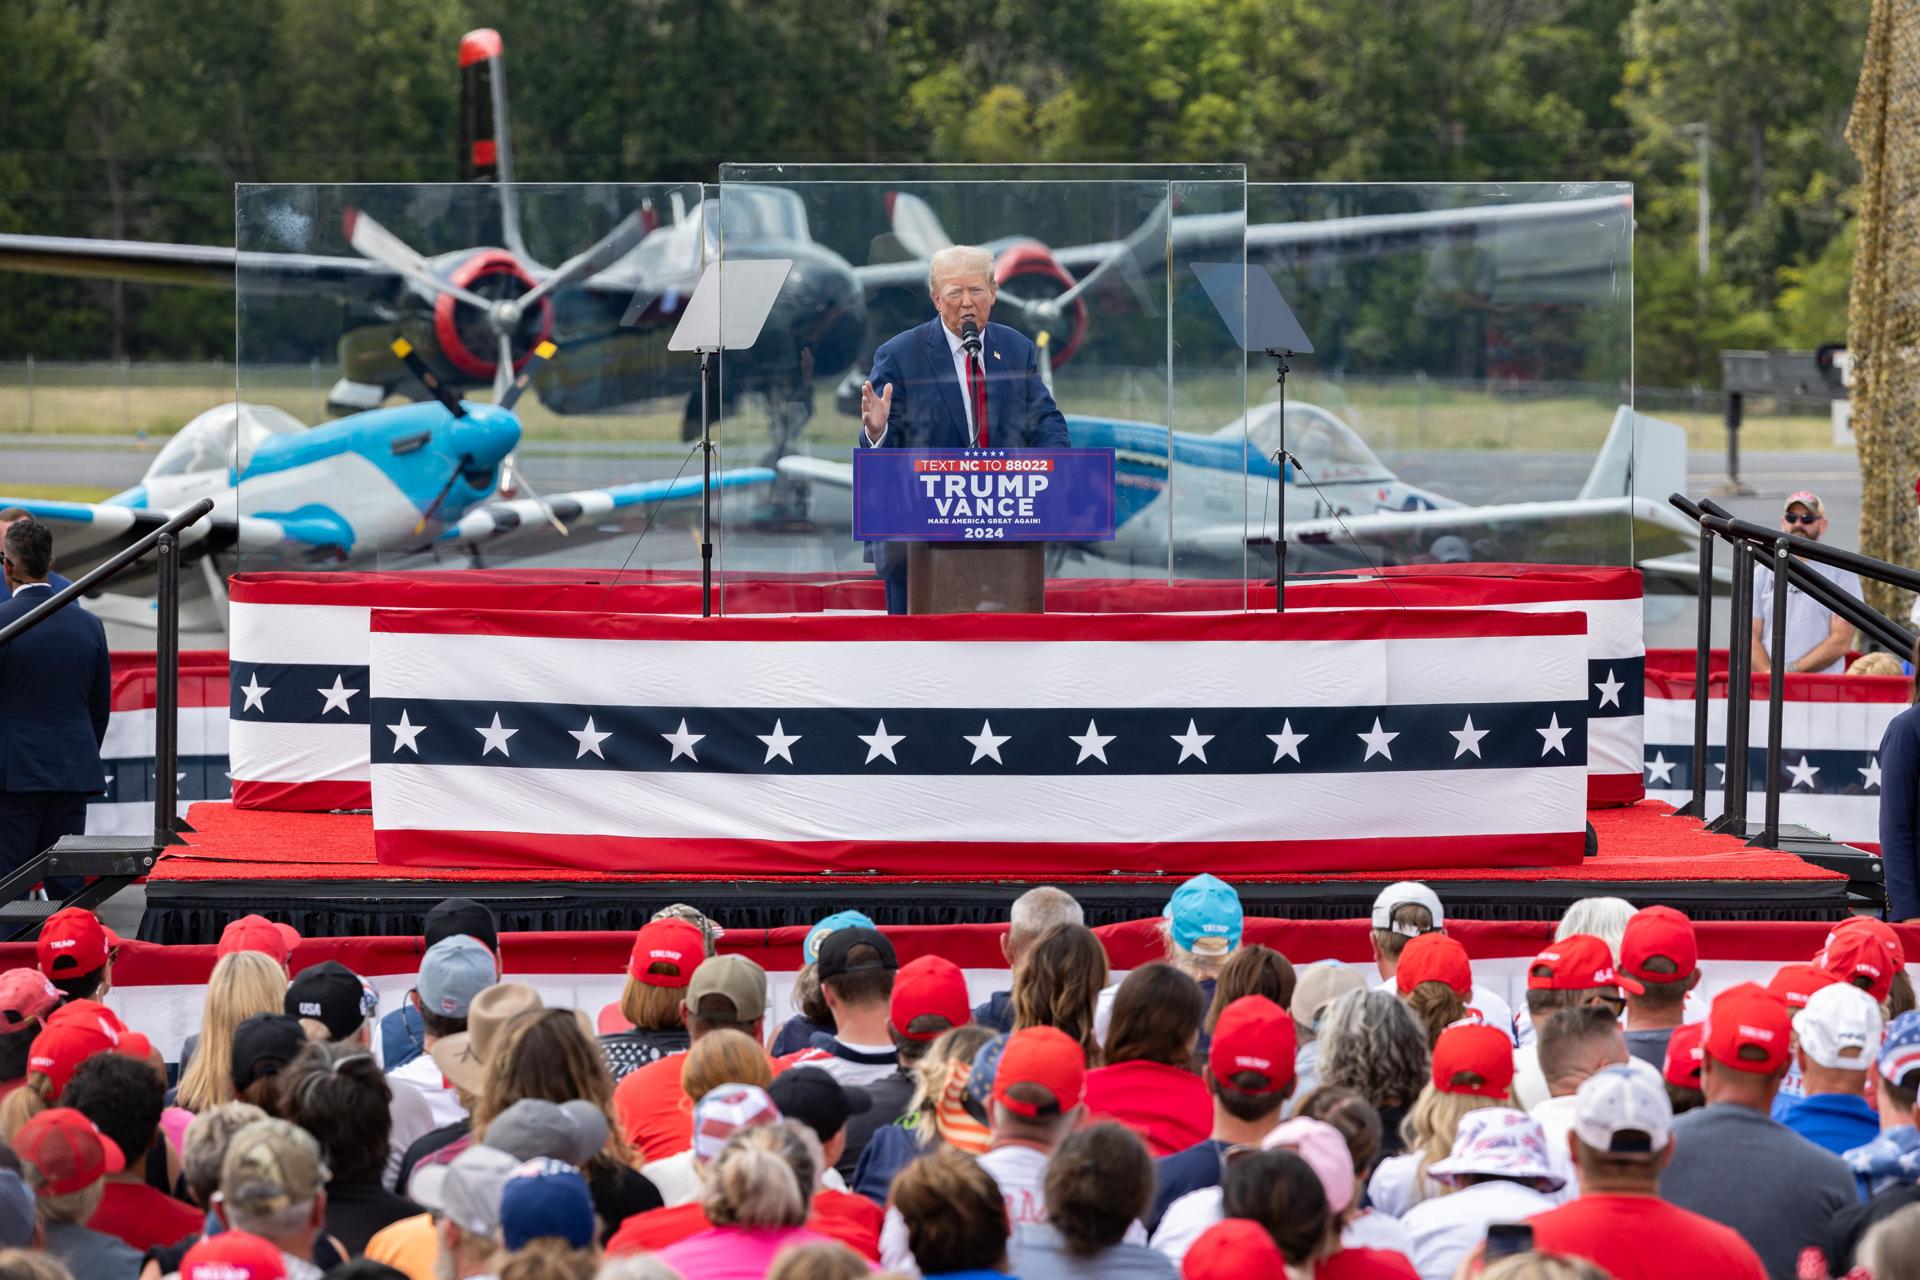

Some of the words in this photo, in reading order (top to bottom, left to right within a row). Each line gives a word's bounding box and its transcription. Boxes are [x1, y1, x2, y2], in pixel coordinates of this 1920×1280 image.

[920, 460, 956, 471] TEXT
[959, 460, 980, 471] NC
[983, 460, 1002, 471] TO
[1005, 460, 1048, 471] 88022
[920, 475, 1048, 498] TRUMP
[934, 498, 1034, 517] VANCE
[964, 528, 1004, 538] 2024
[1202, 924, 1229, 934] TRUMP
[49, 939, 77, 950] TRUMP
[649, 949, 682, 961] TRUMP
[298, 1002, 322, 1016] USA
[1738, 1024, 1775, 1041] TRUMP
[1235, 1055, 1270, 1070] TRUMP
